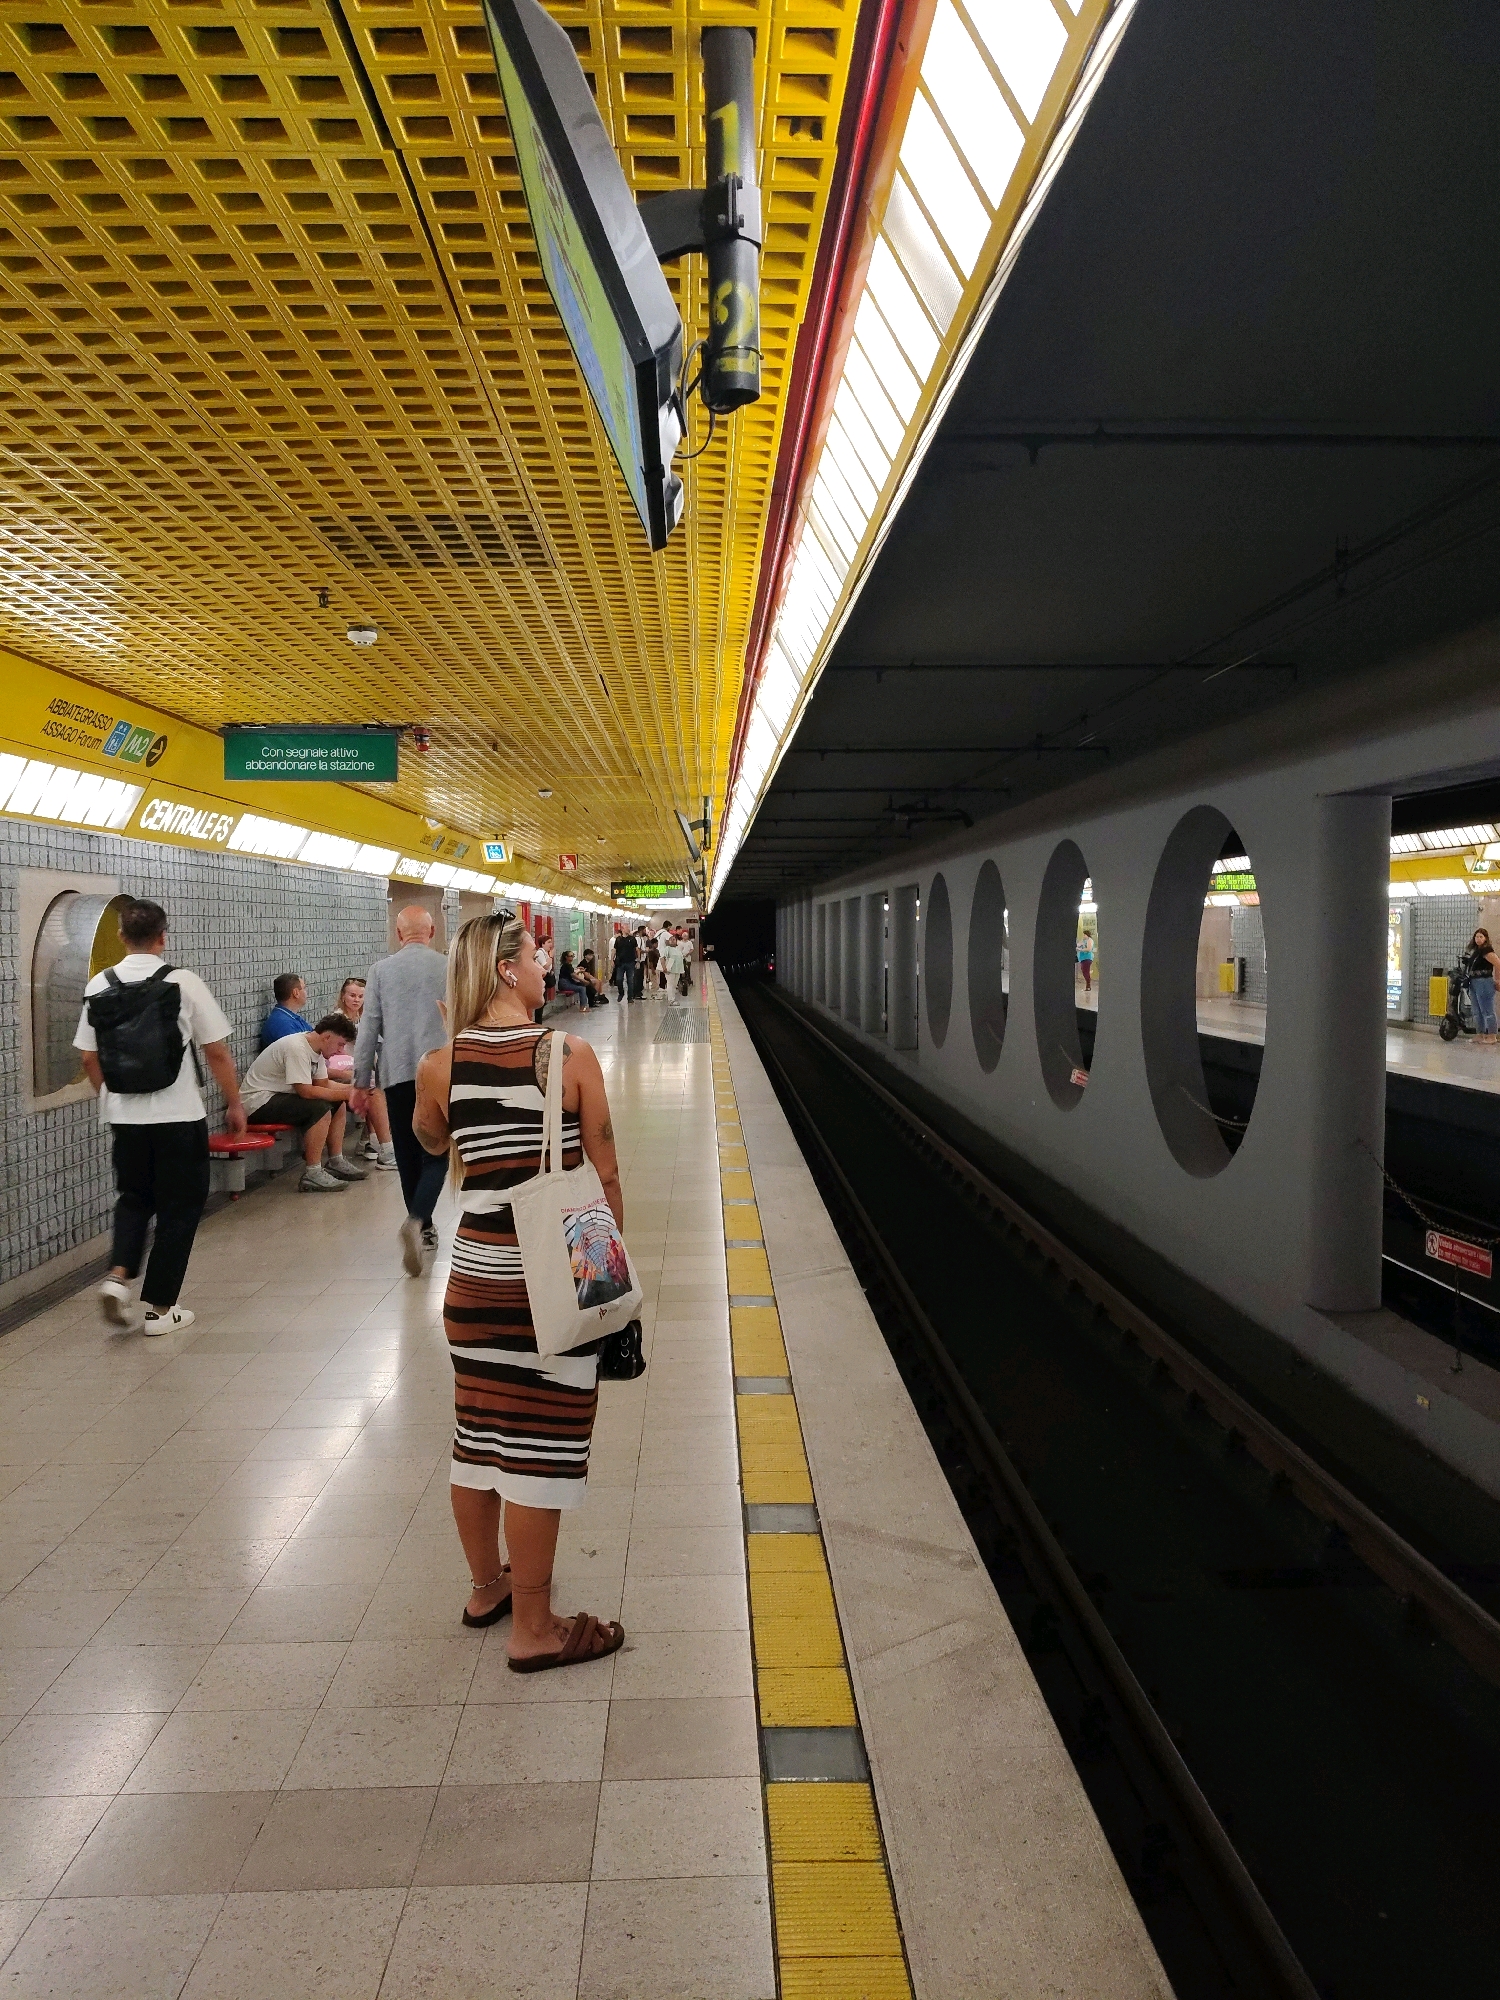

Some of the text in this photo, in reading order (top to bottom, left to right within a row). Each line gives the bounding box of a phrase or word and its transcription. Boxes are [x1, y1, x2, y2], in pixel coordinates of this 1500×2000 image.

[45, 697, 114, 731] ABBIATEGRASSO
[40, 719, 103, 751] ASSAGO Forum
[124, 734, 150, 757] M2
[261, 747, 359, 759] Con segnale attivo
[245, 760, 375, 770] abbandonare la stazione
